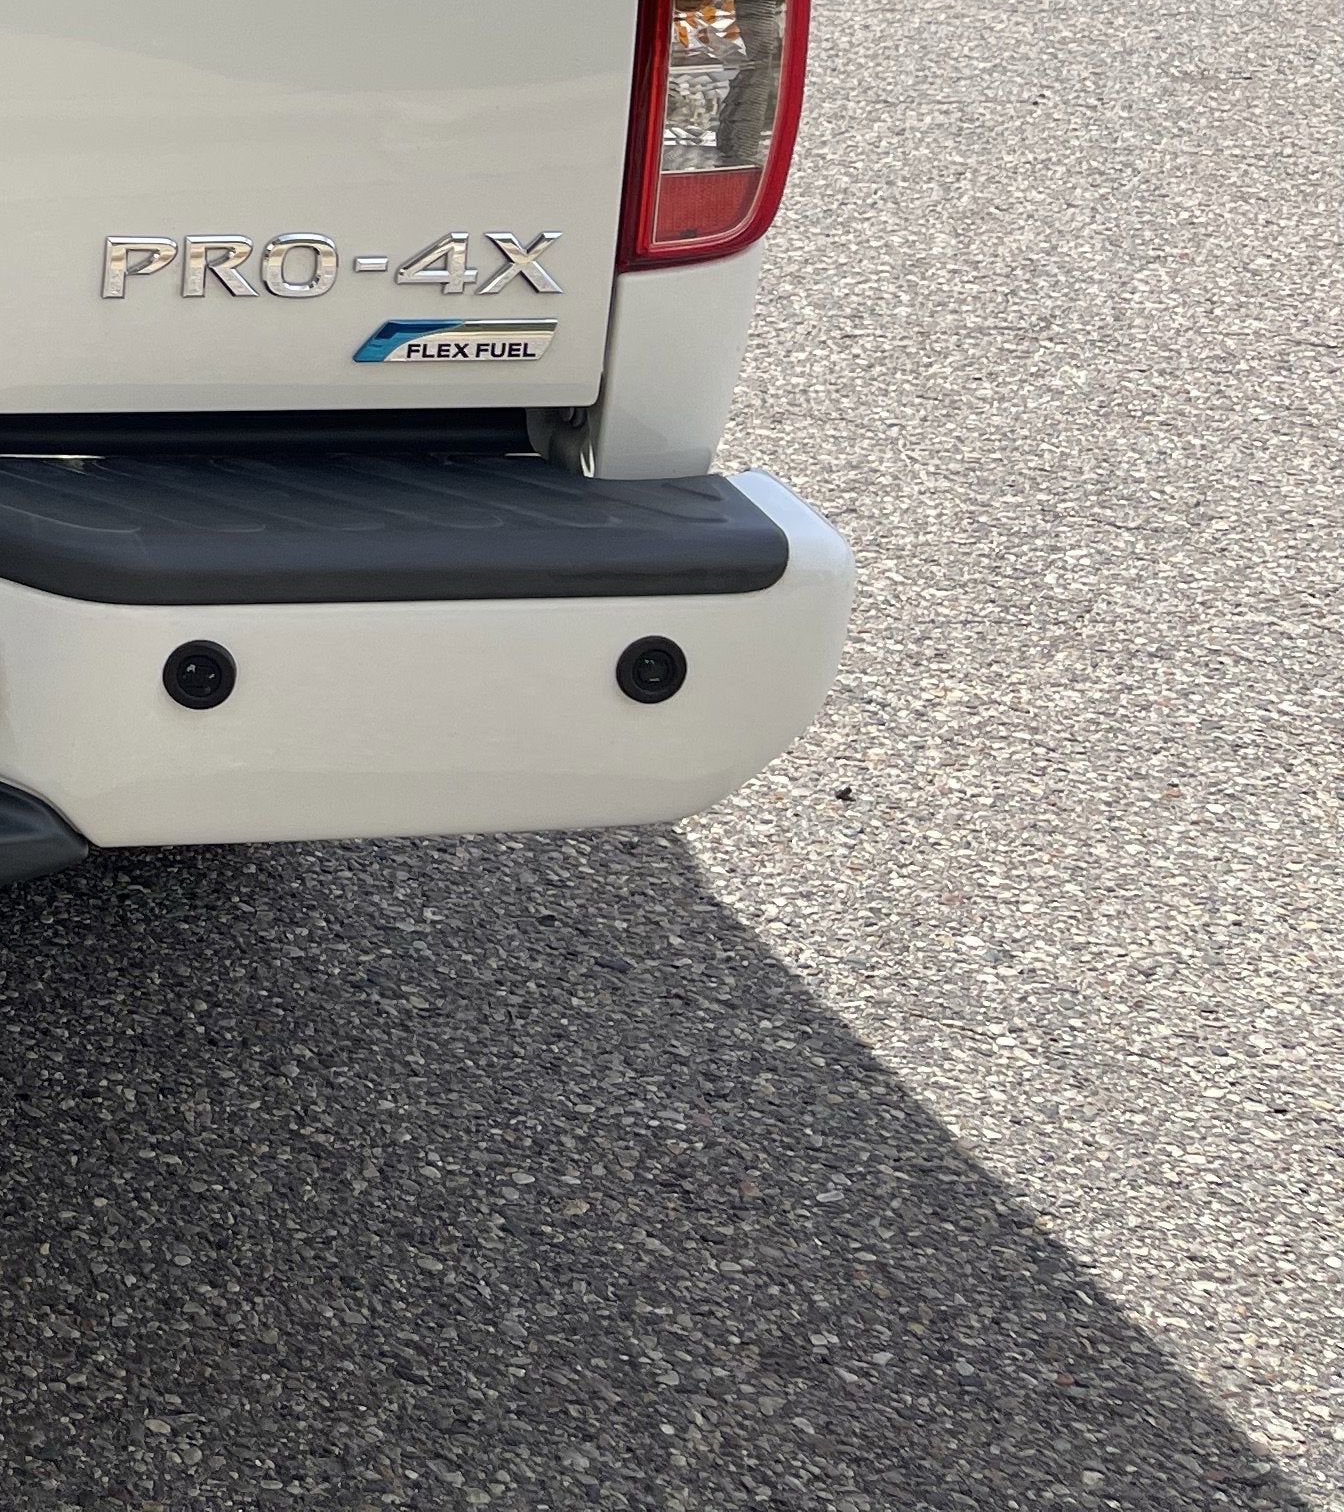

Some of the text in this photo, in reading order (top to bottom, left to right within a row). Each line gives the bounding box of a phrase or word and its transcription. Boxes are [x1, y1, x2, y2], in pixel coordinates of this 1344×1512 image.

[102, 231, 564, 299] PRO-4X
[406, 342, 536, 359] FLEX FUEL
